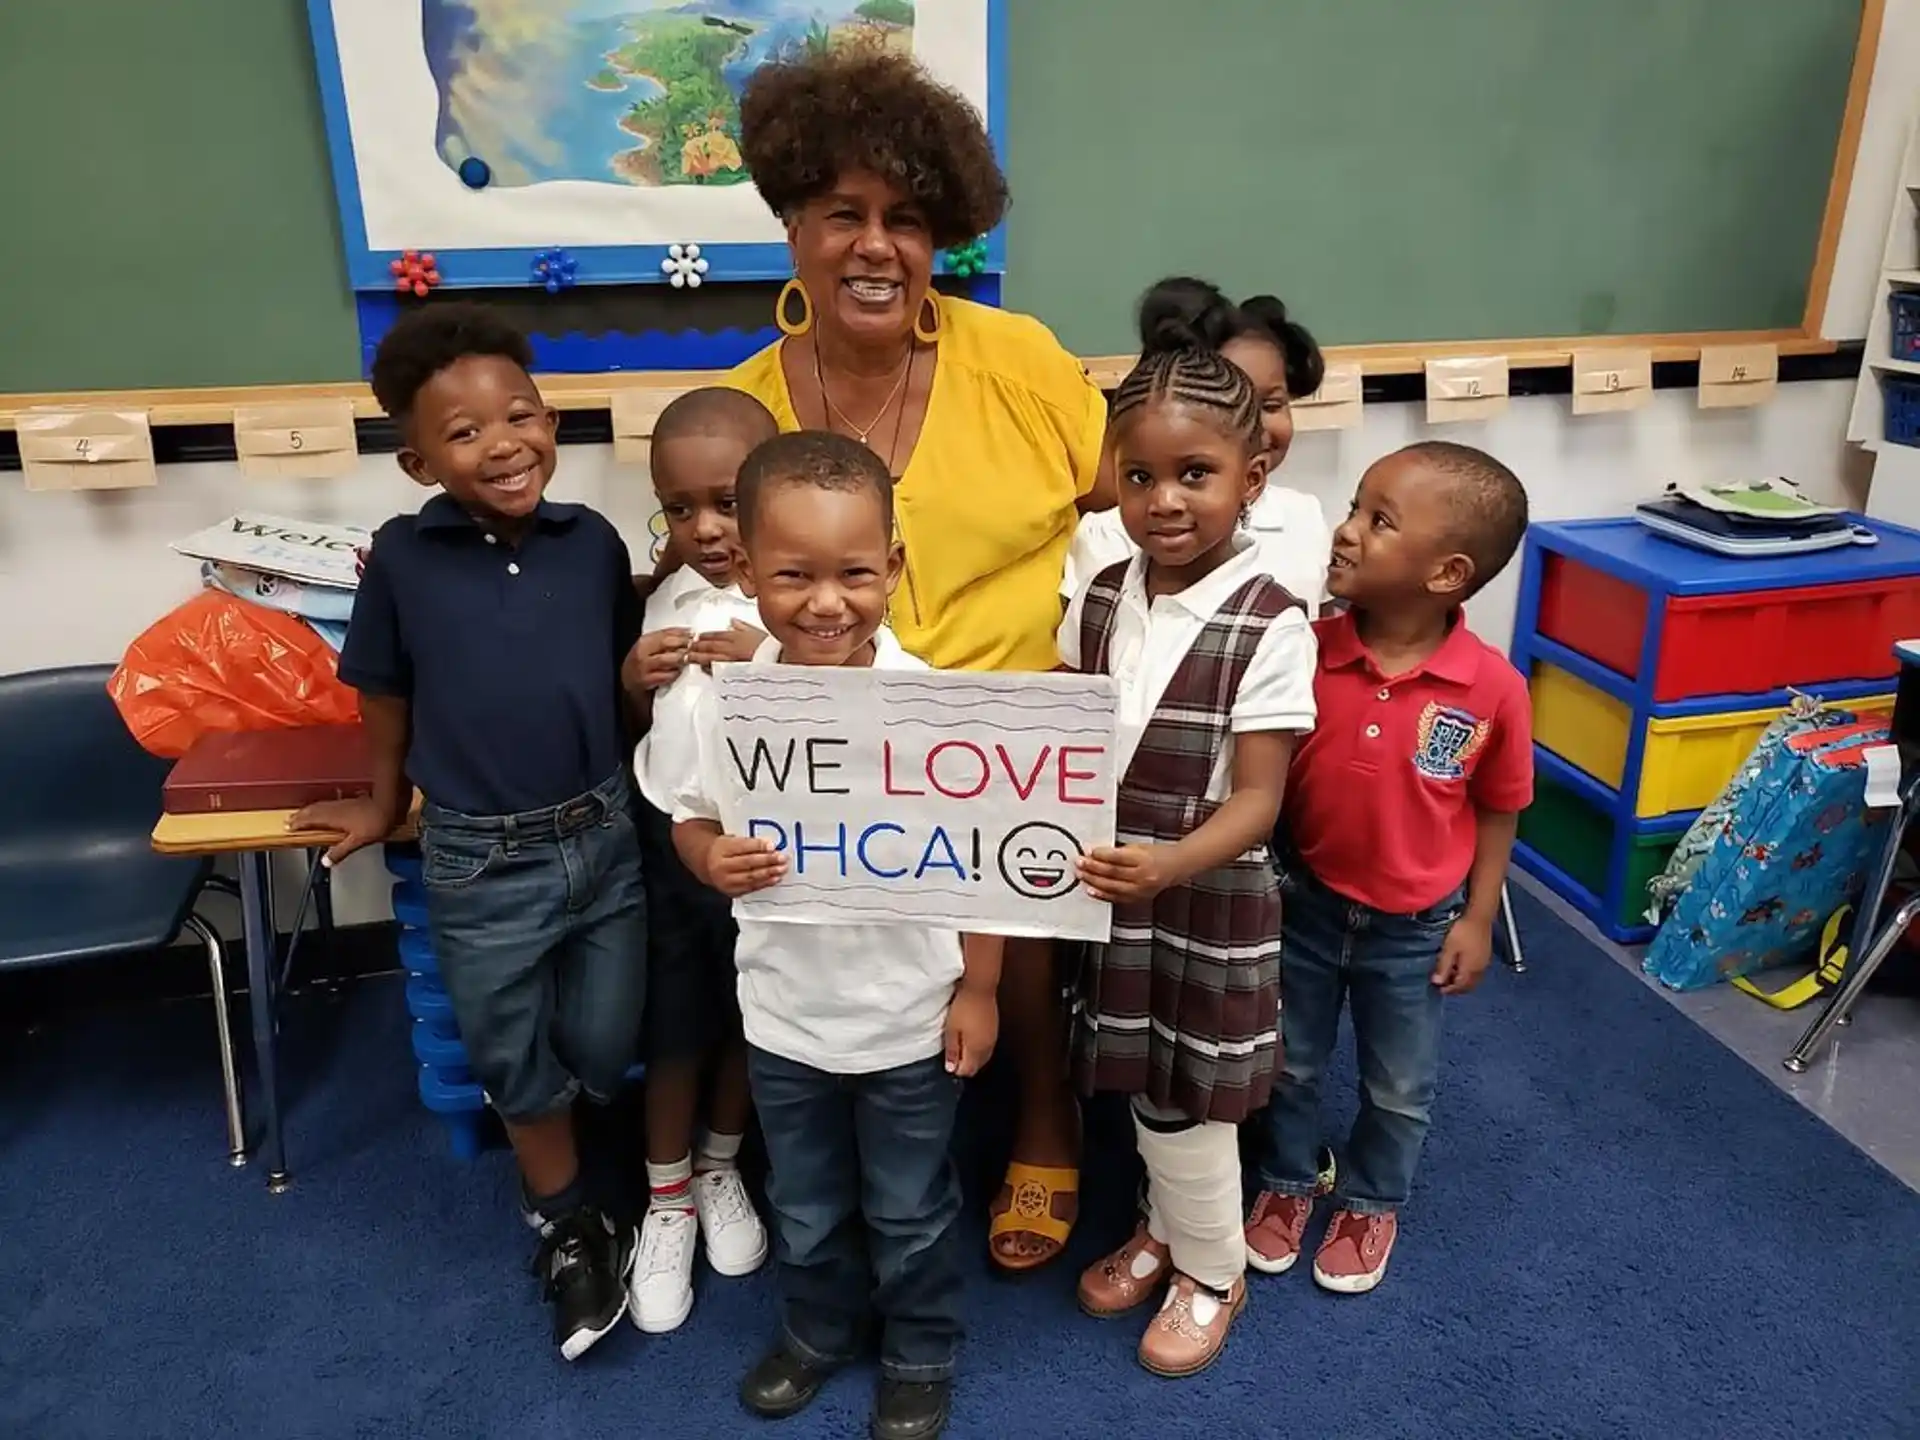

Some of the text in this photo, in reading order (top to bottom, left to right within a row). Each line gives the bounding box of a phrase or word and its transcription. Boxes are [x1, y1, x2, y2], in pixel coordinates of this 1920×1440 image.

[1605, 372, 1620, 391] 13
[1731, 366, 1747, 381] 14
[1467, 380, 1481, 396] 12
[76, 439, 92, 457] 4
[290, 430, 304, 450] 5
[726, 736, 1105, 806] WE LOVE
[748, 818, 982, 882] PHCA!
